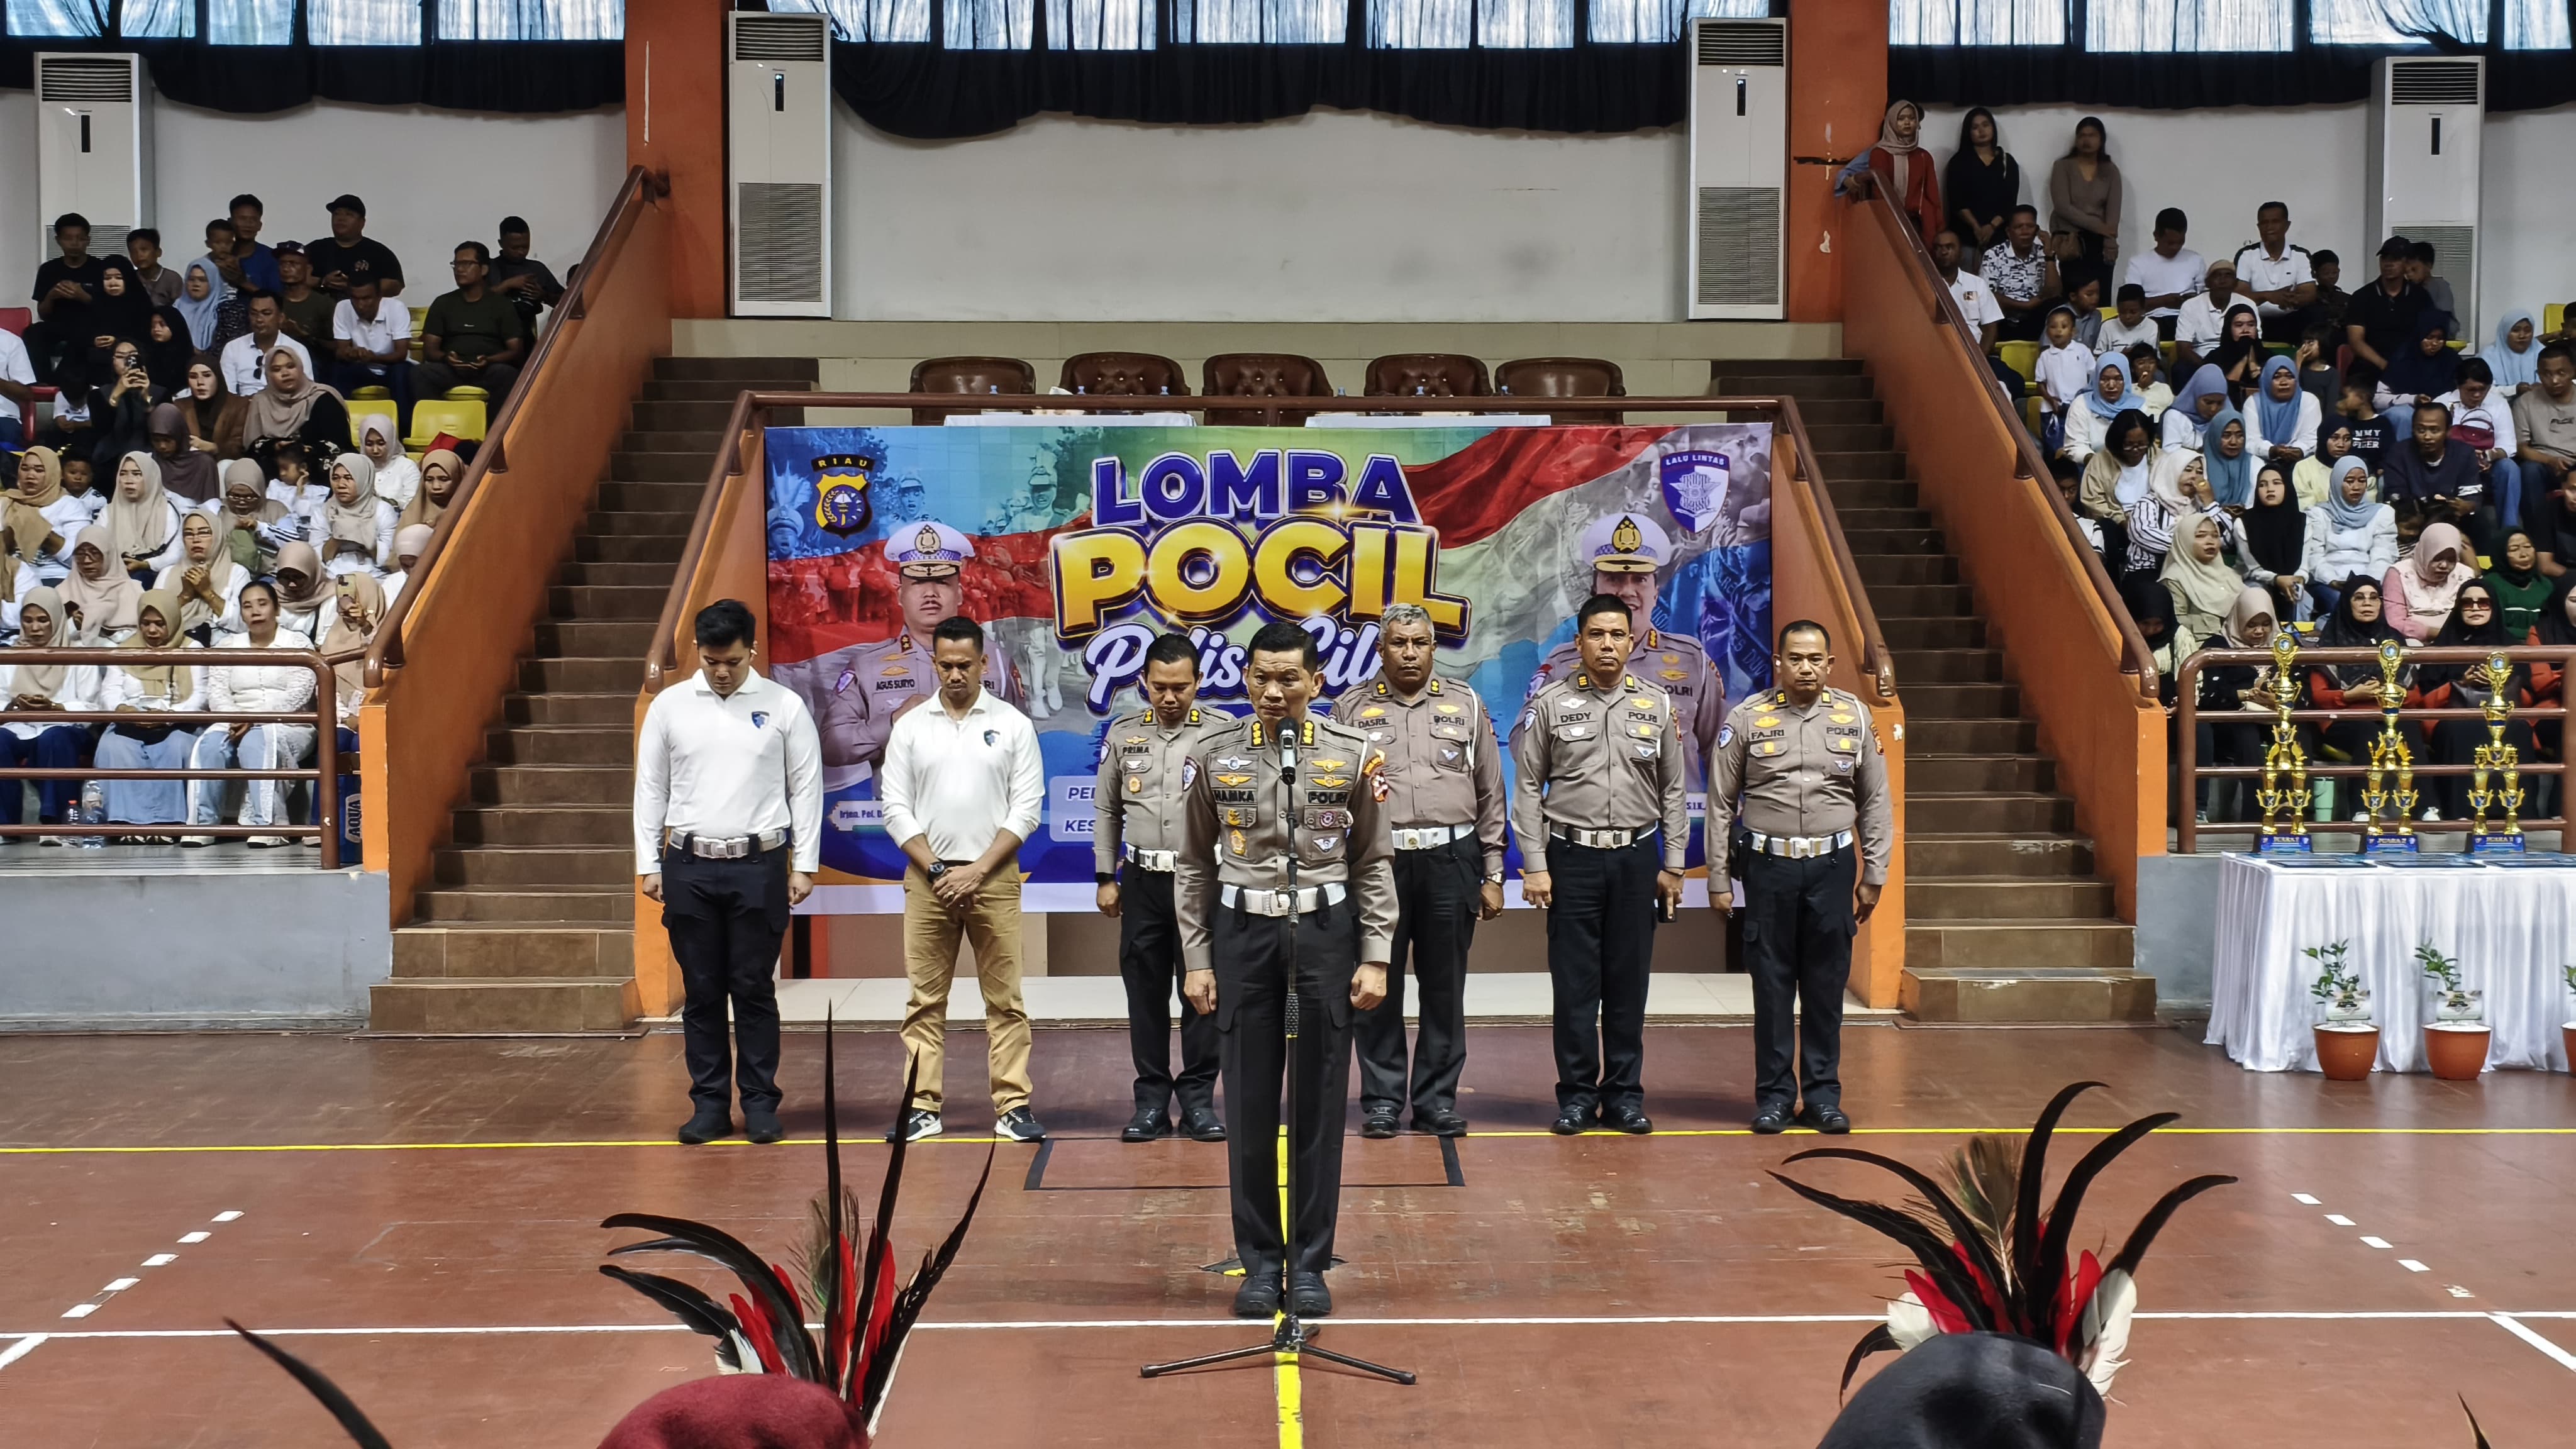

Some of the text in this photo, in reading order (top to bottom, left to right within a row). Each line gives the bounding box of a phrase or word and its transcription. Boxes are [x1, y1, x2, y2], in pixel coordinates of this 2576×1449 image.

[818, 458, 867, 467] RIAU
[1666, 455, 1724, 465] LALU LINTAS
[1092, 448, 1423, 527] LOMBA
[1052, 517, 1471, 638] POCIL
[1664, 685, 1692, 697] OLRI
[1433, 715, 1465, 726] POLRI
[1560, 711, 1592, 723] DEDY
[1628, 711, 1657, 723] POLRI
[1358, 718, 1389, 729] DASRIL
[1751, 729, 1784, 740] FAJRI
[1826, 726, 1858, 736] POLRI
[1123, 746, 1150, 754] PRIMA
[1069, 787, 1096, 799] PE
[1214, 790, 1255, 802] HAMKA
[348, 799, 362, 837] AQUA
[1065, 820, 1096, 832] KES
